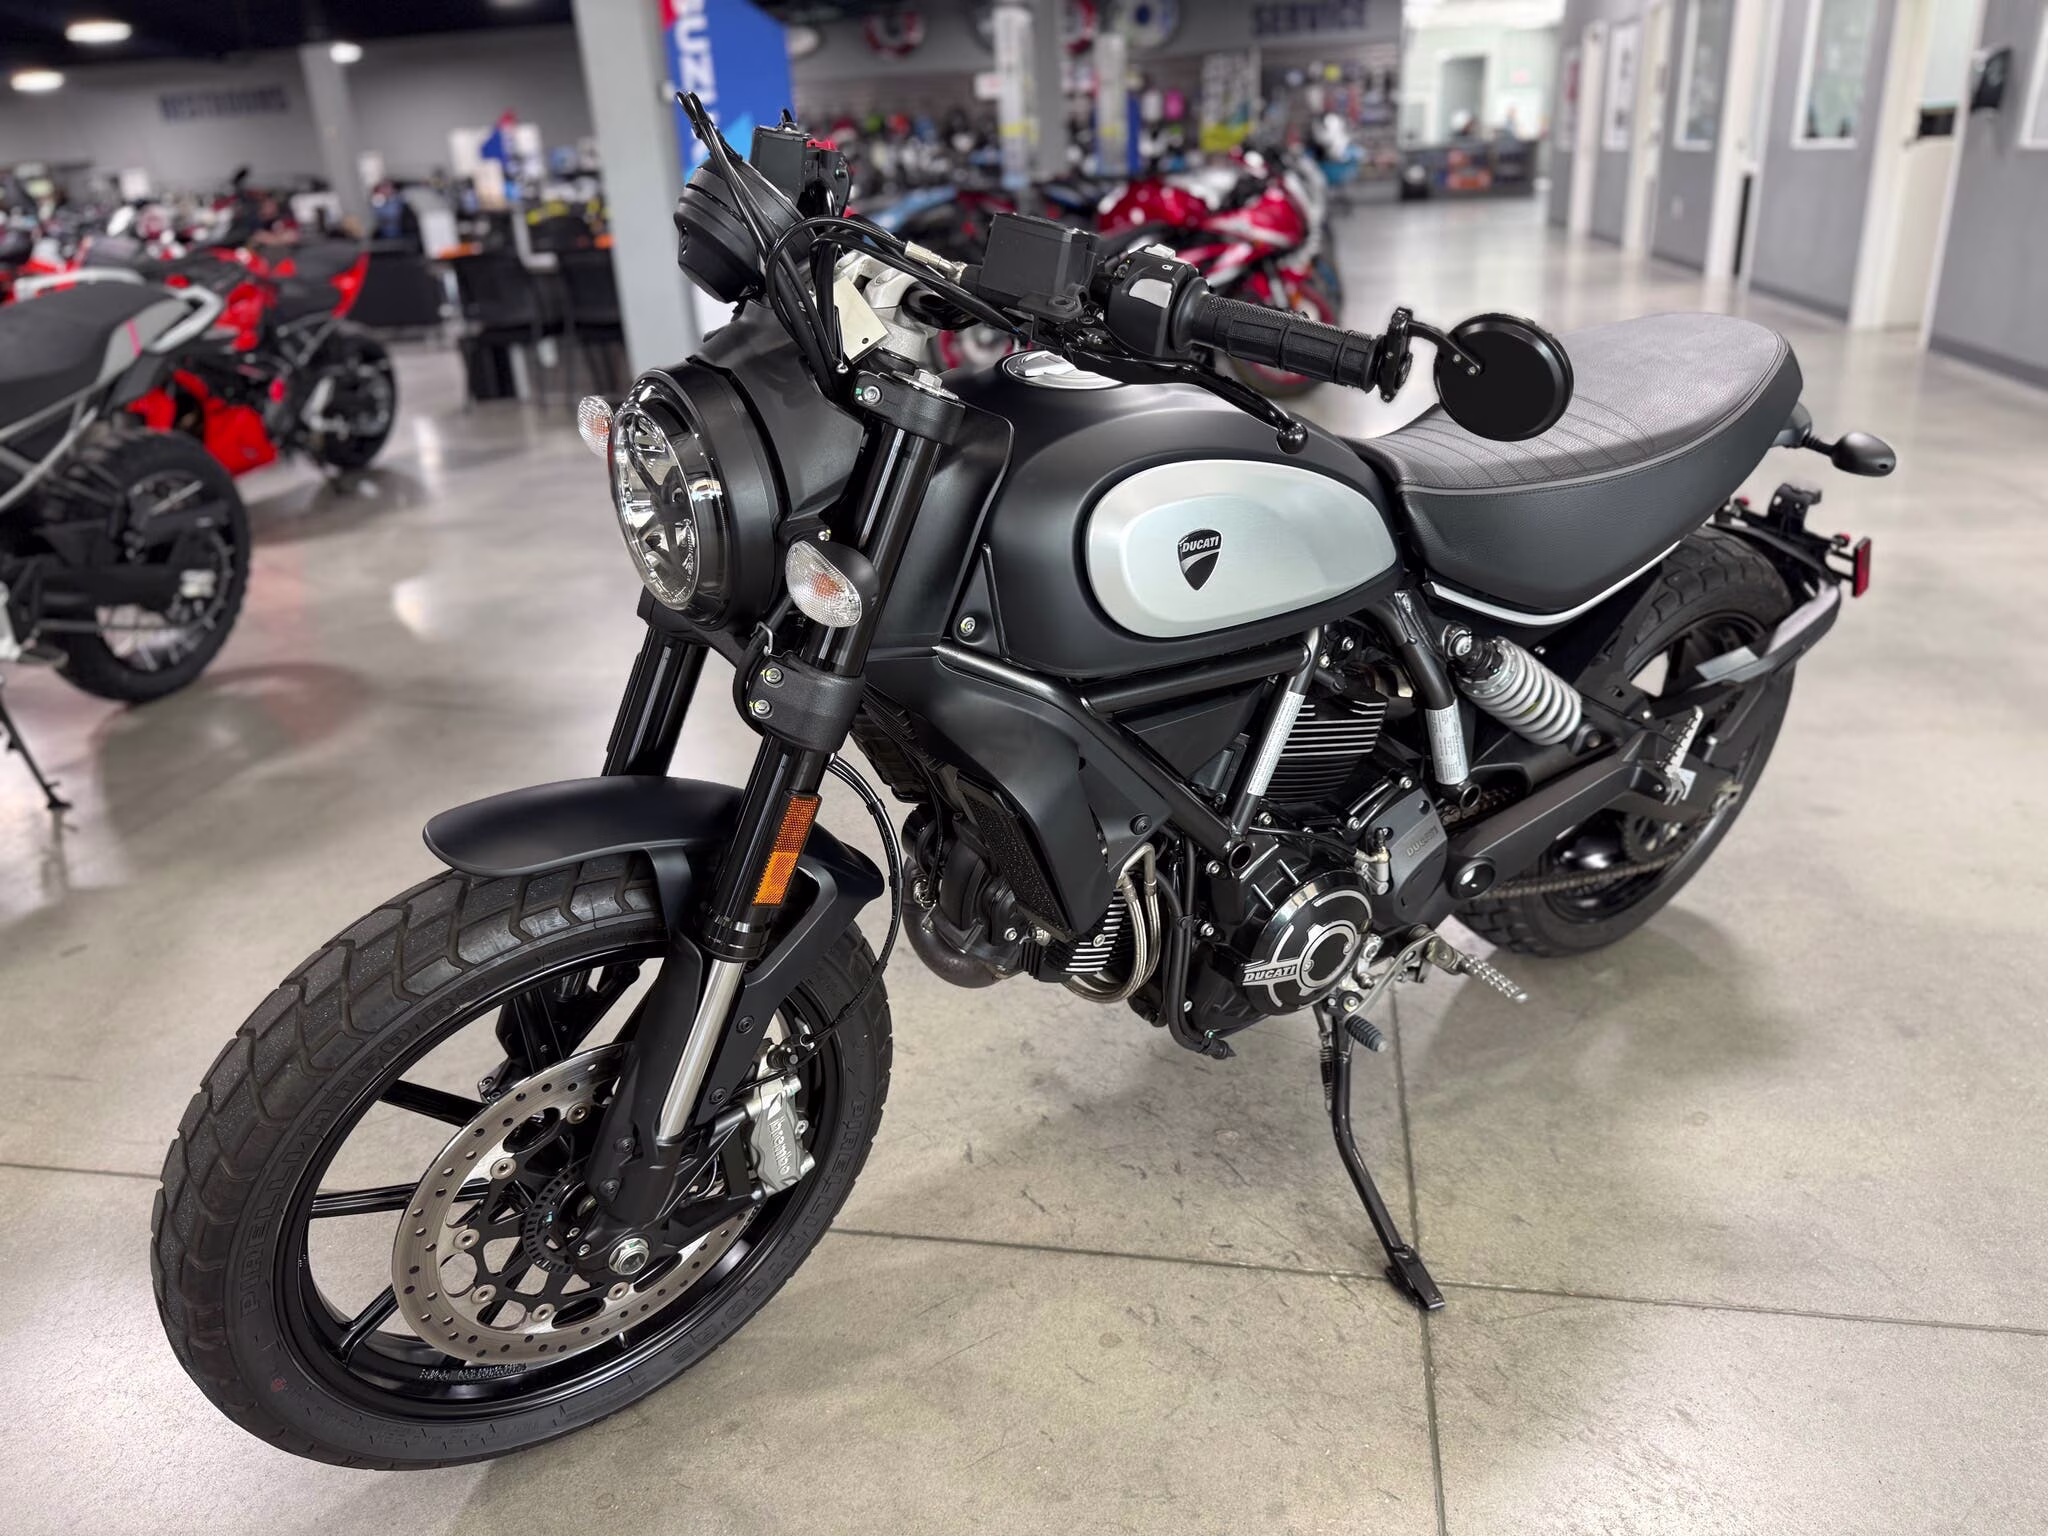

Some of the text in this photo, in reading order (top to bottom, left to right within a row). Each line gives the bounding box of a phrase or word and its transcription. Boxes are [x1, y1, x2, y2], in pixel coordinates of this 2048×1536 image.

[1182, 535, 1219, 553] DUCATI
[1243, 965, 1297, 982] DUCATI
[768, 1115, 792, 1175] brembo
[802, 1099, 867, 1230] PIRELLI
[240, 1150, 302, 1319] PIRELLI
